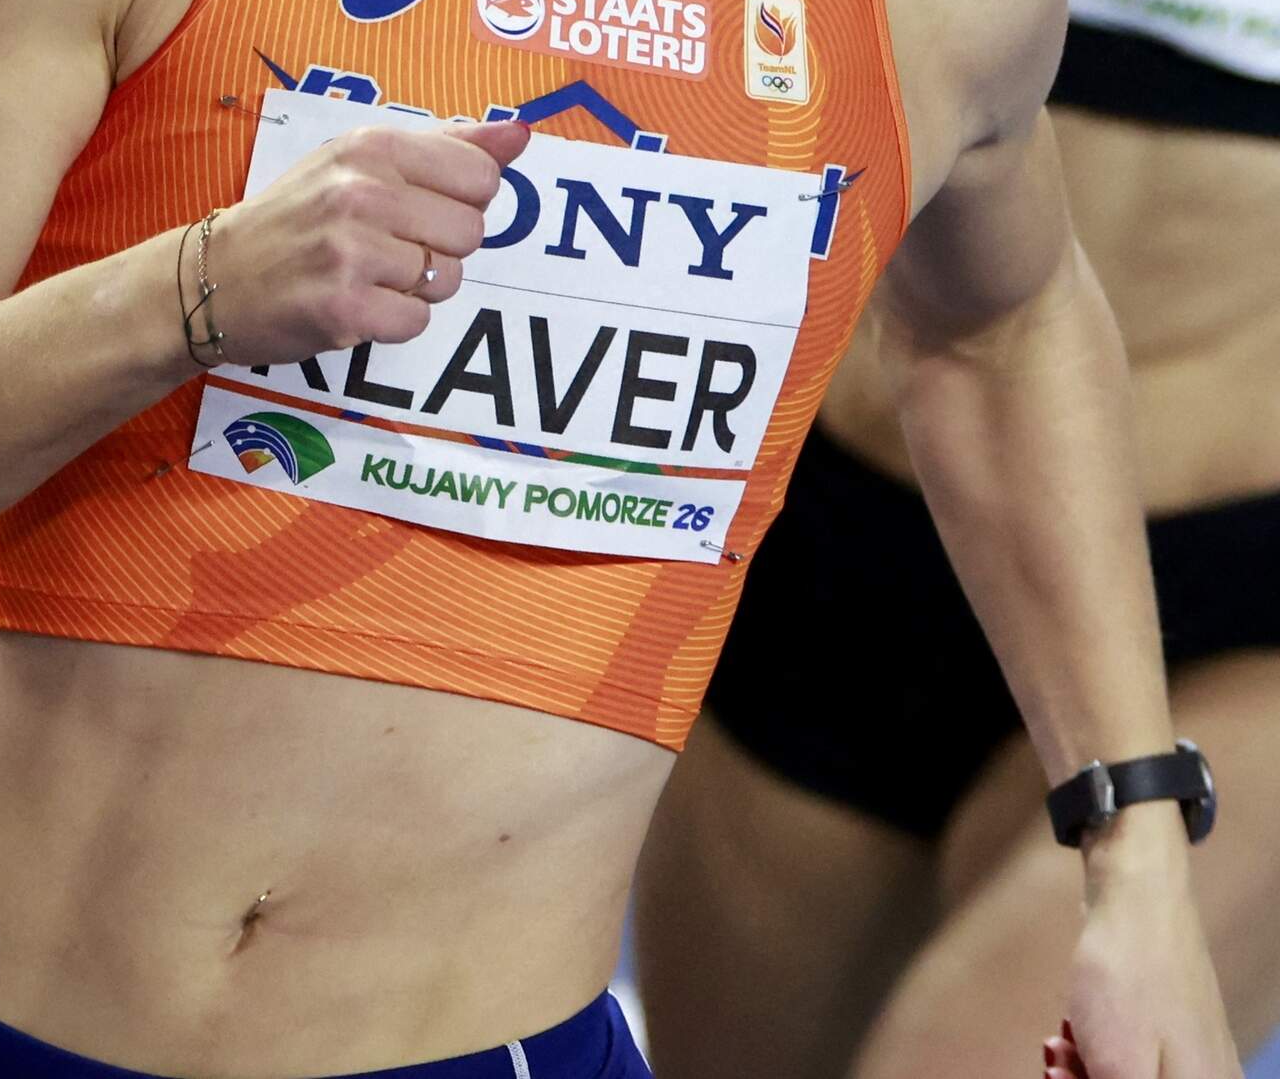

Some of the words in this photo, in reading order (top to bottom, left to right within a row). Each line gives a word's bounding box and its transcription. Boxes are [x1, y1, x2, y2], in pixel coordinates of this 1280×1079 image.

[549, 18, 706, 76] LOTERIJ
[758, 63, 796, 74] TeamNL
[480, 166, 768, 281] ONY
[250, 308, 757, 454] LAVER
[360, 453, 518, 510] KUJAWY
[522, 483, 674, 528] POMORZE
[672, 503, 714, 532] 26
